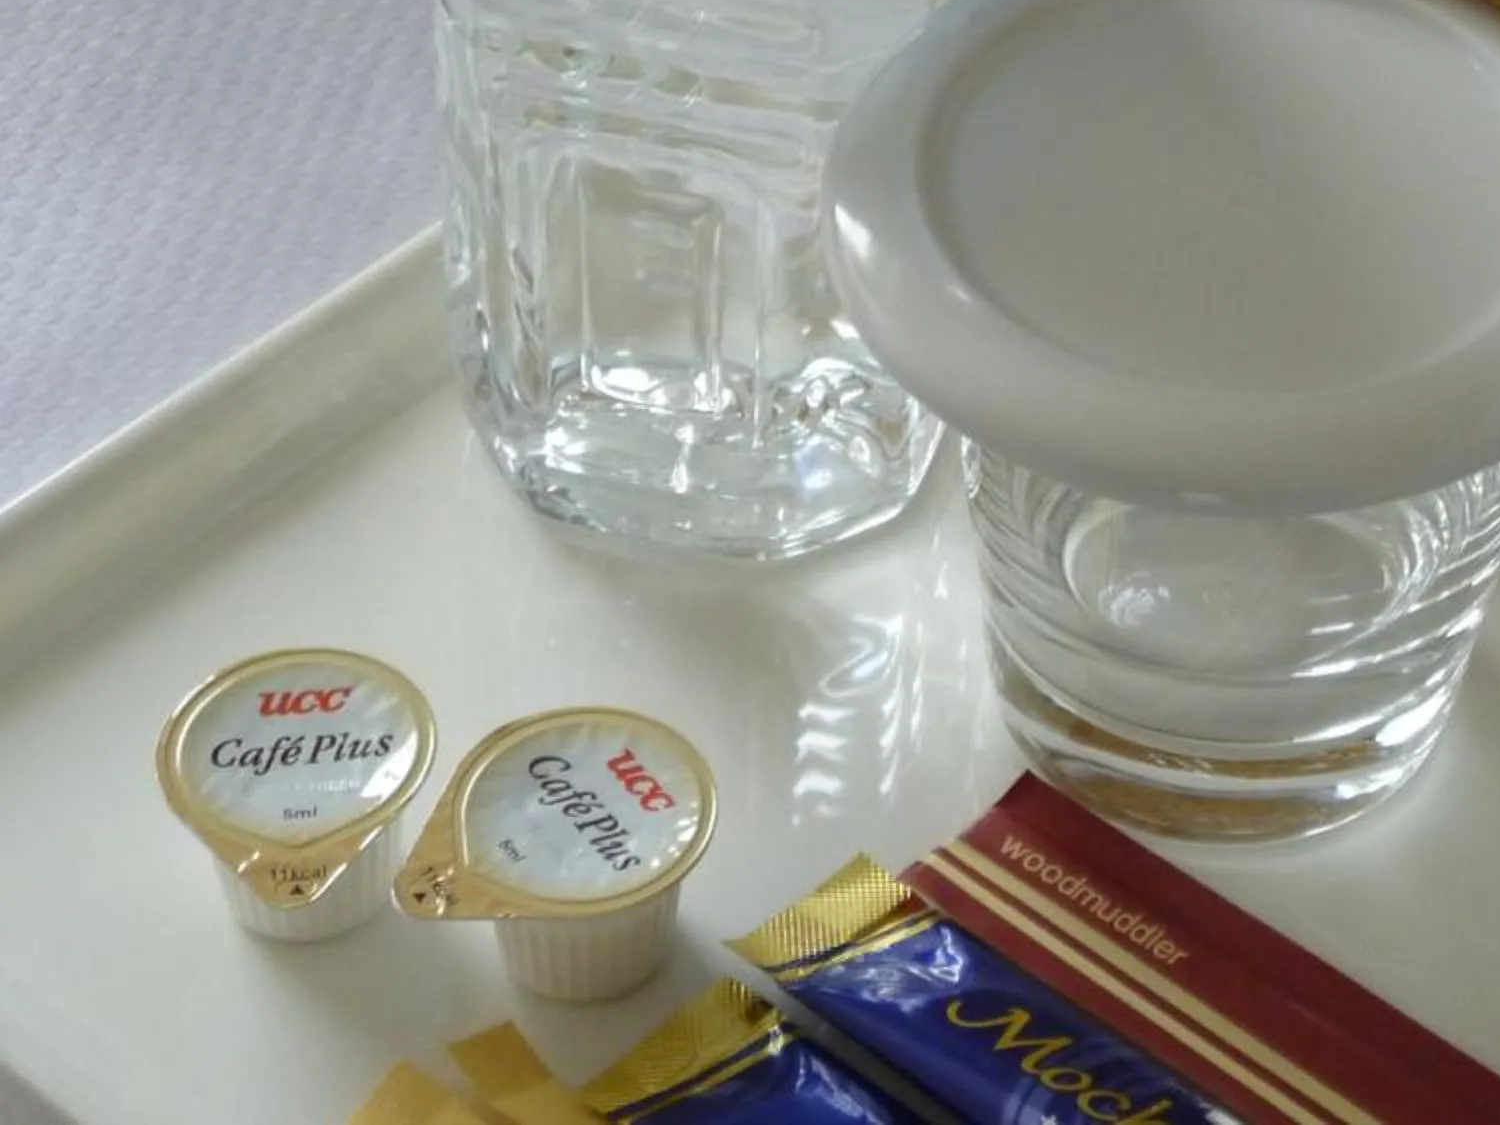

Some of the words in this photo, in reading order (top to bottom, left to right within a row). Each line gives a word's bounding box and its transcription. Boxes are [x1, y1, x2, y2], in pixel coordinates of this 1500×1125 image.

[210, 735, 304, 776] Café
[304, 731, 395, 765] Plus
[528, 755, 606, 819] Café
[572, 811, 642, 873] Plus
[1000, 835, 1190, 967] woodmuddler
